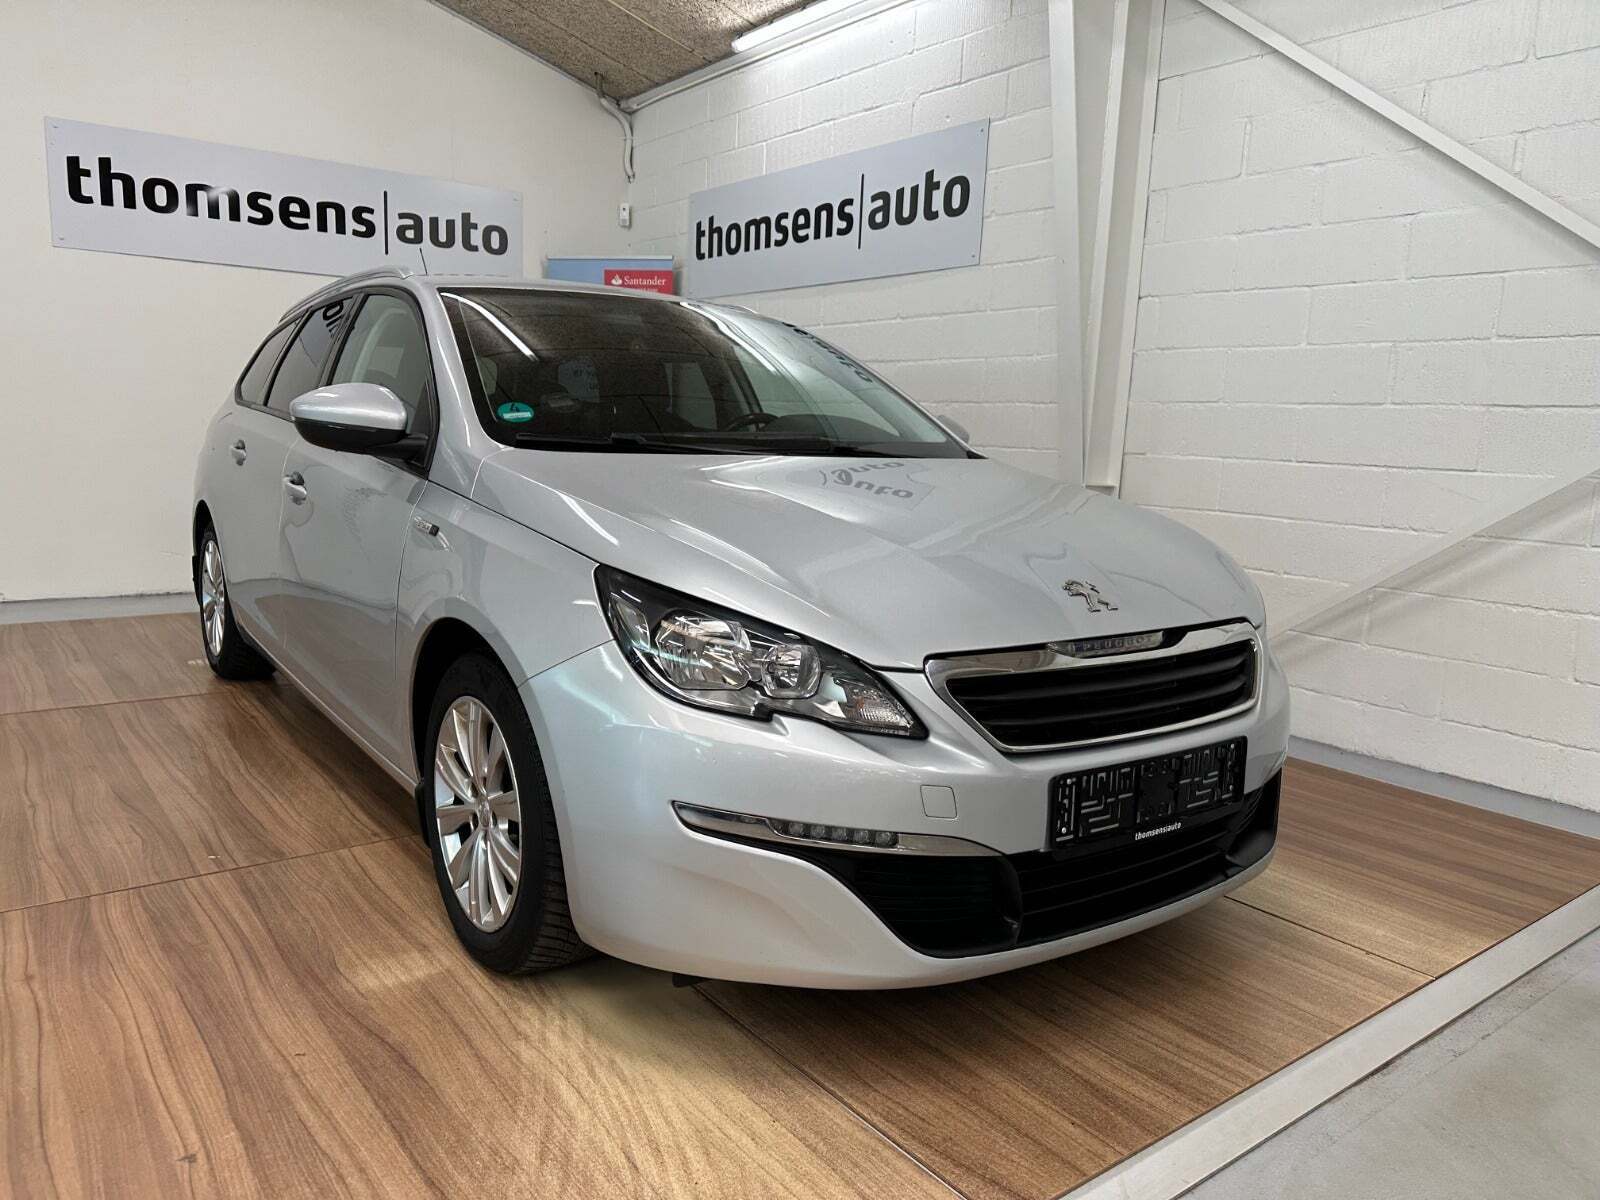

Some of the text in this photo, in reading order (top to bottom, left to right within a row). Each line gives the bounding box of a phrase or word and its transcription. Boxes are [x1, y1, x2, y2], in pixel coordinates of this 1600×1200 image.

[66, 156, 508, 255] thomsens auto
[696, 169, 970, 260] thomsens auto
[624, 275, 666, 286] Santander
